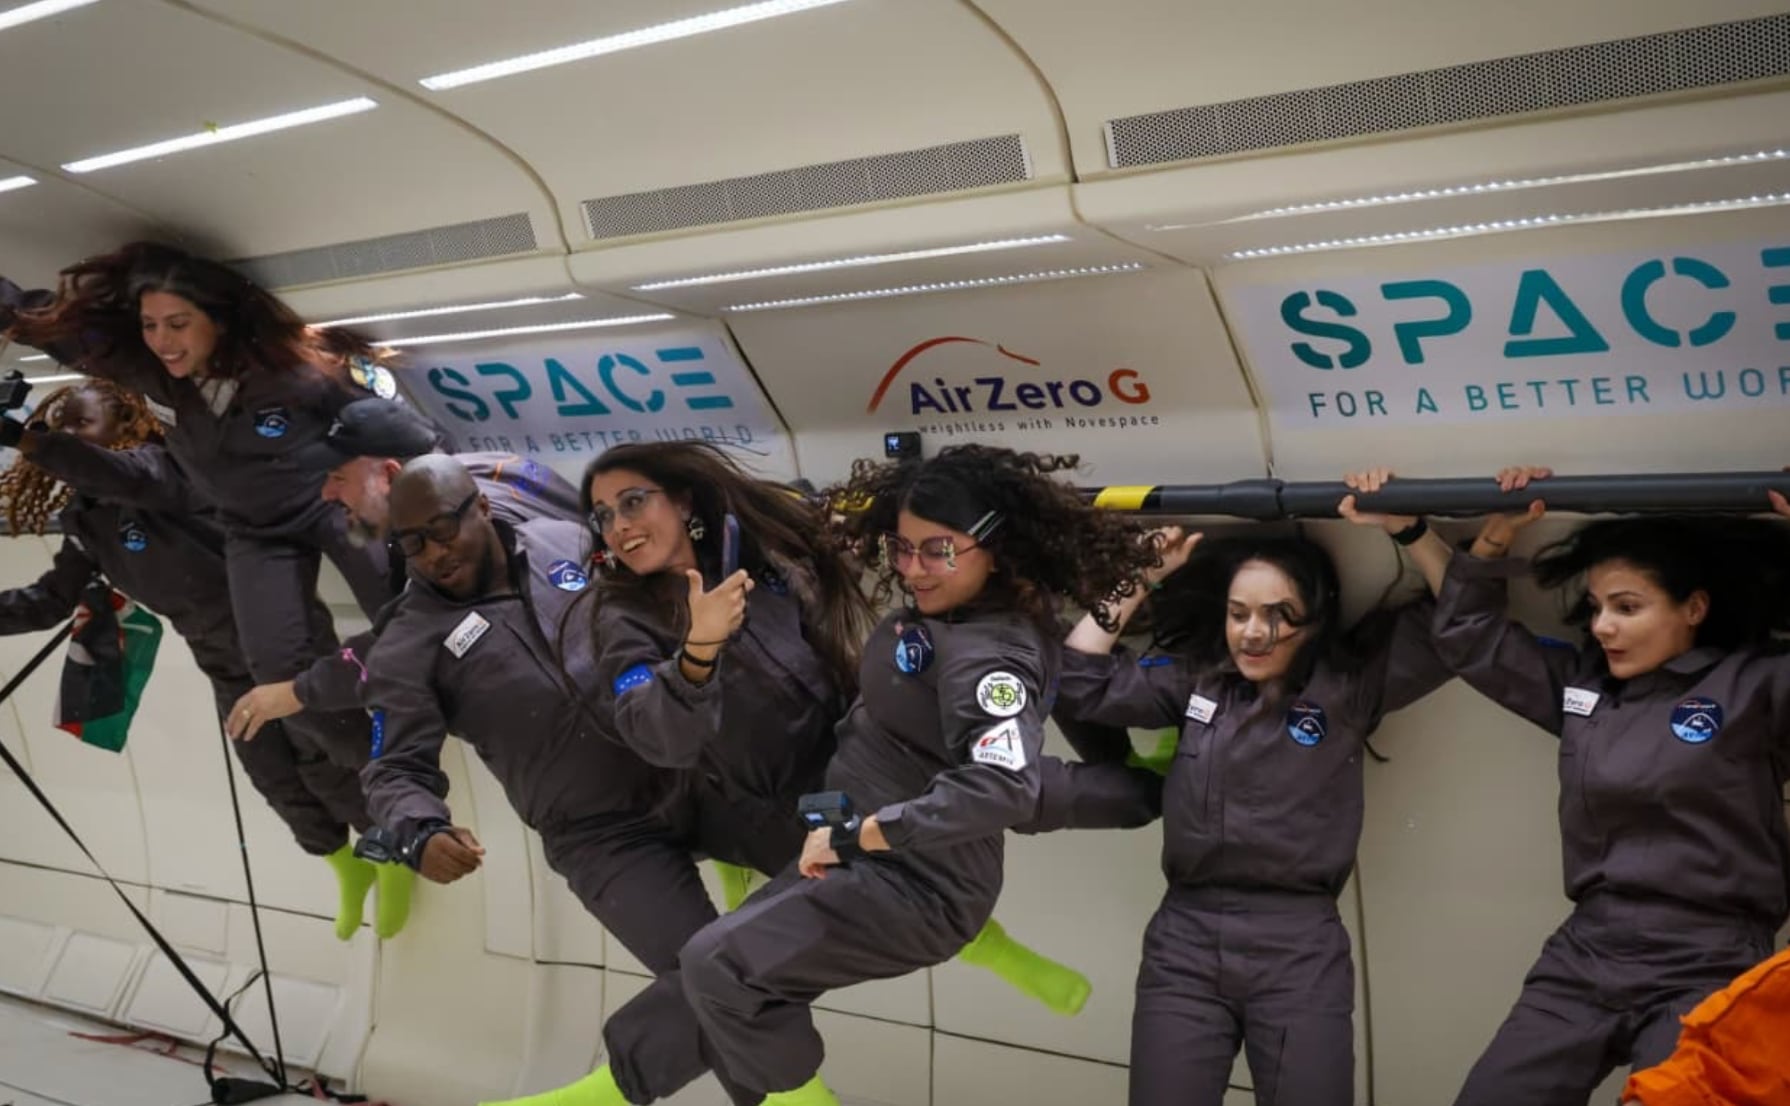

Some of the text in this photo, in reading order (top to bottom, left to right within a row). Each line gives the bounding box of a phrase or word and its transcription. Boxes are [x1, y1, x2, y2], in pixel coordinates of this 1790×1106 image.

[428, 347, 734, 423] SPACE
[1309, 390, 1388, 418] FOR
[1416, 388, 1439, 414] A
[1465, 376, 1651, 411] BETTER
[470, 435, 515, 454] FOR
[525, 436, 541, 453] A
[553, 429, 642, 452] BETTER
[919, 415, 1160, 436] weightless with Novespace
